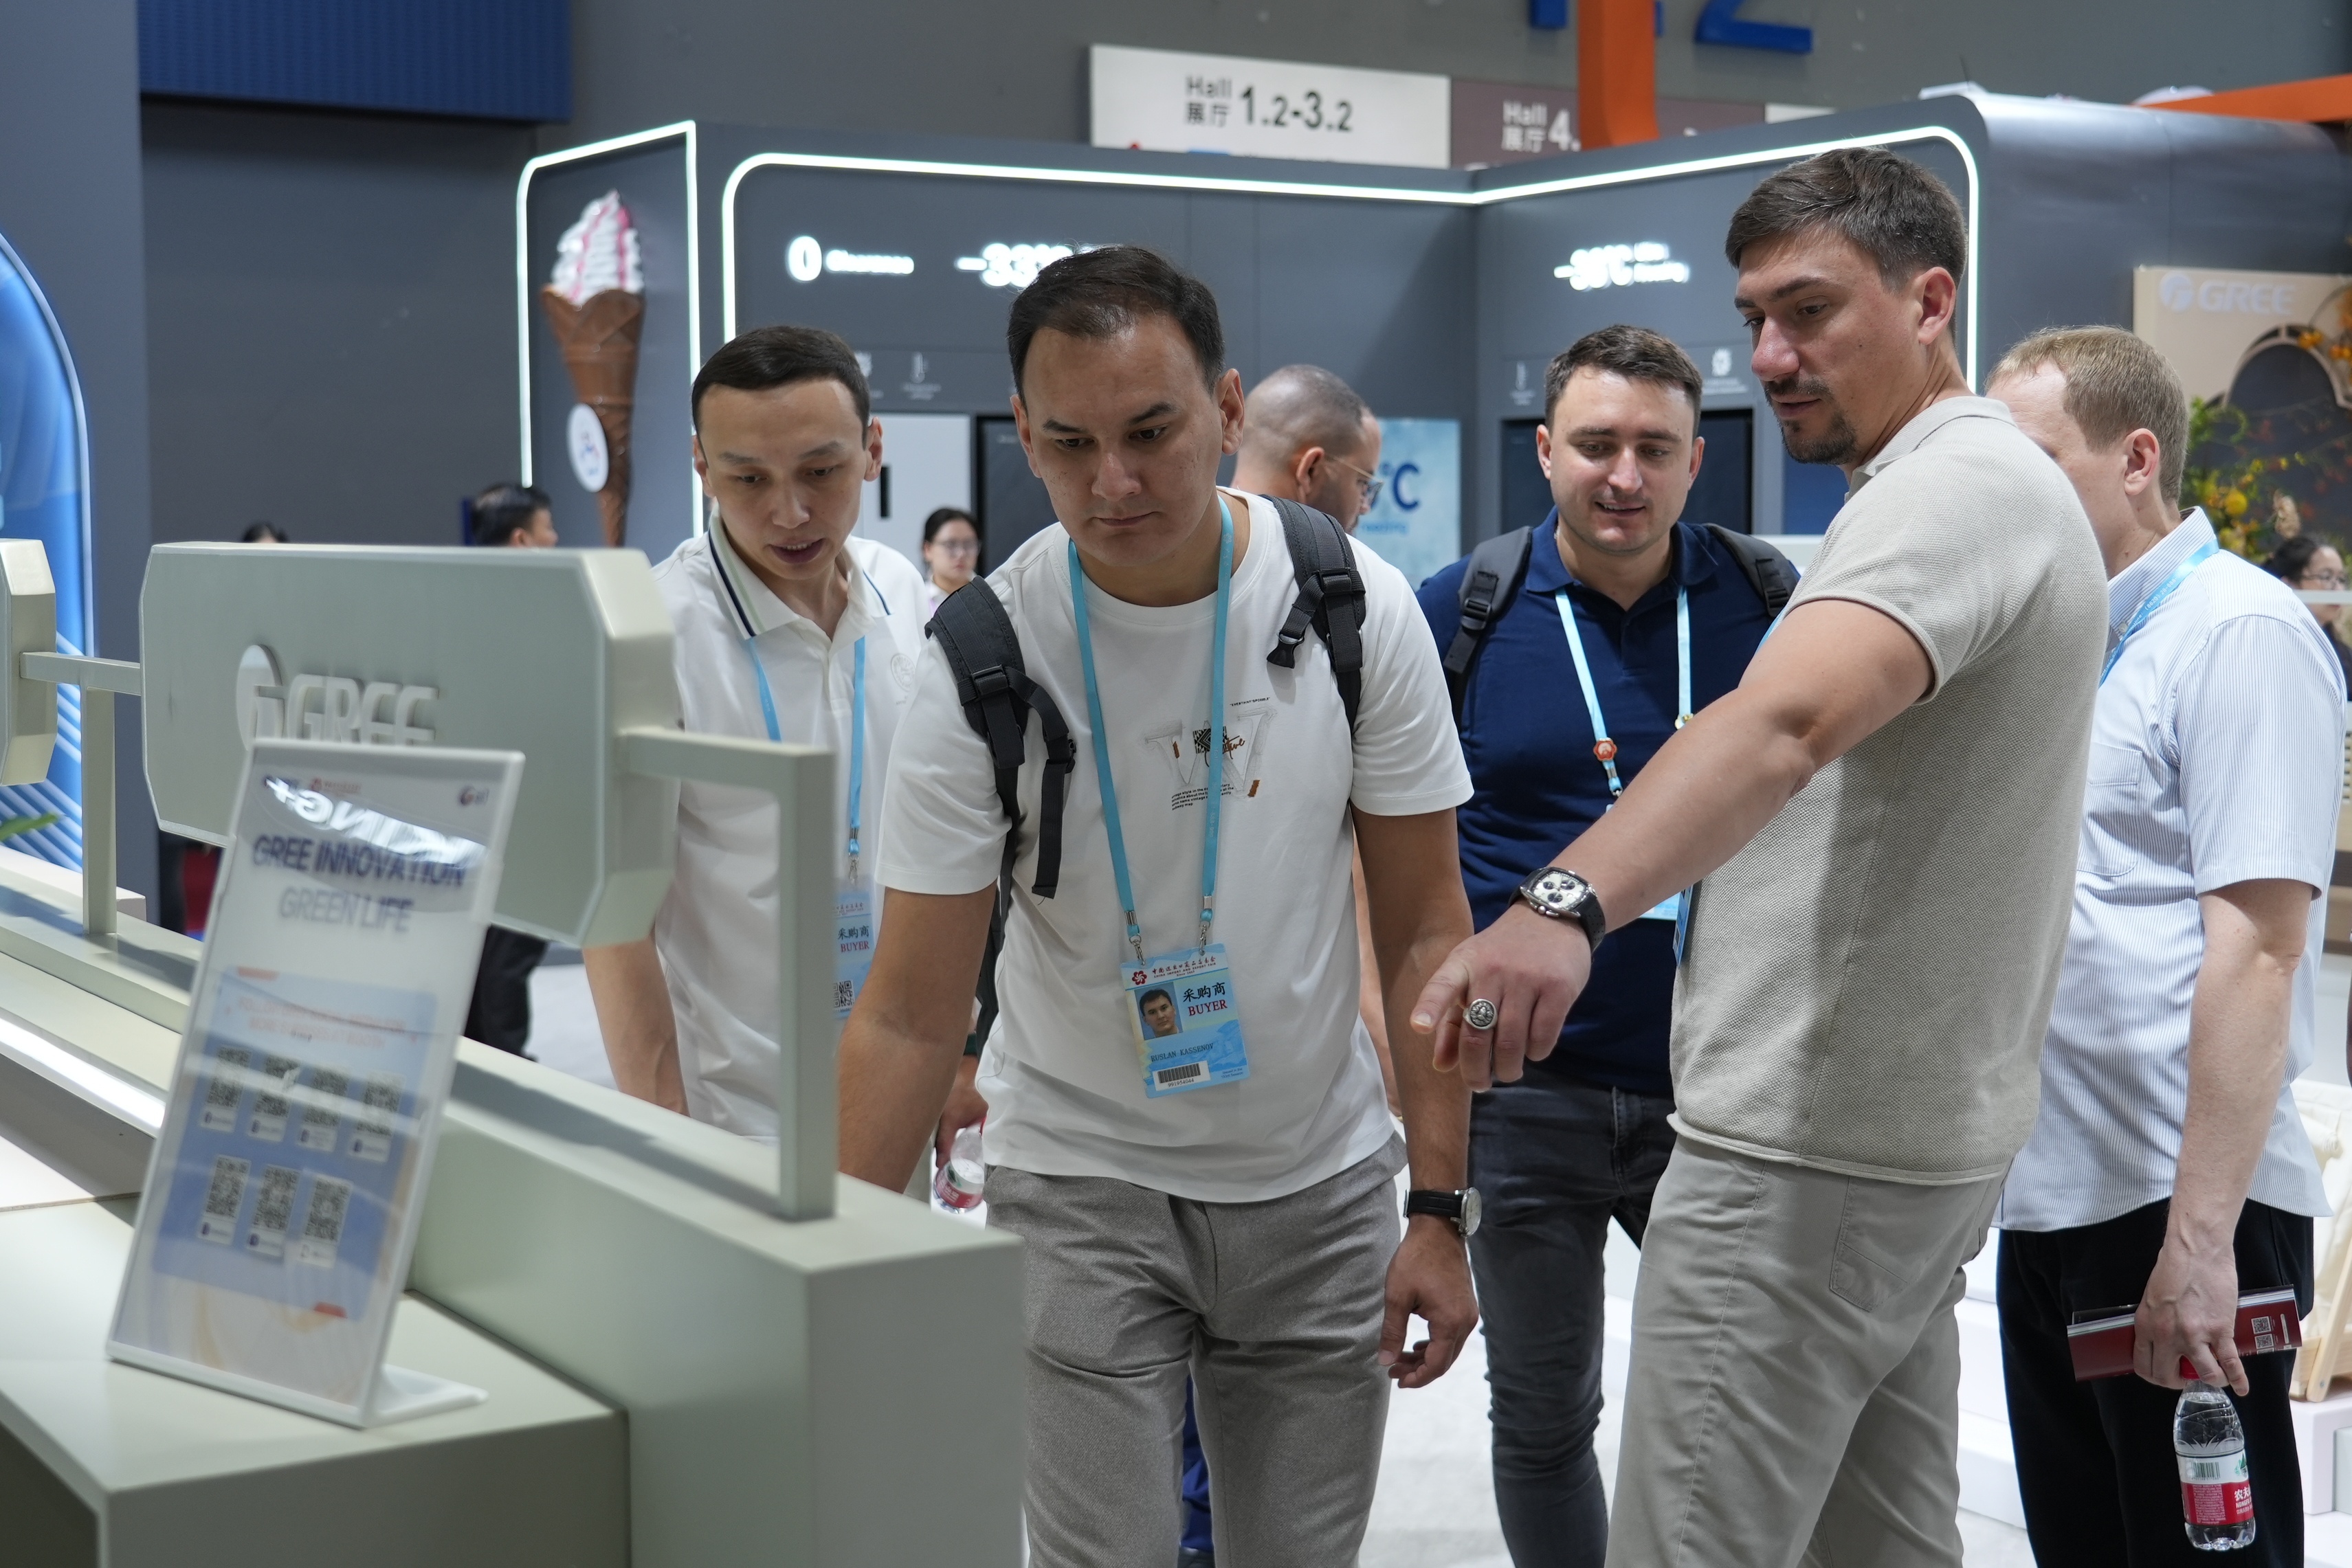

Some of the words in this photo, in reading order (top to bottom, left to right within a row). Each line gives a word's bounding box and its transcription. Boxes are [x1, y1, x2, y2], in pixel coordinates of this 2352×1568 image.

[1186, 76, 1232, 99] Hall
[1187, 101, 1230, 127] 展厅
[1241, 85, 1352, 132] 1.2-3.2
[1503, 100, 1547, 124] Hall
[1371, 460, 1421, 513] °C
[287, 673, 440, 746] GREE
[252, 834, 315, 874] GREE
[313, 839, 468, 888] INNOVATION
[279, 885, 362, 928] GREEN
[359, 893, 414, 933] LIFE
[841, 941, 870, 953] BUYER
[1183, 982, 1225, 1003] 采购商
[1188, 999, 1228, 1016] BUYER
[1151, 1050, 1177, 1062] RUSLAN
[1180, 1042, 1214, 1056] KASSENOV
